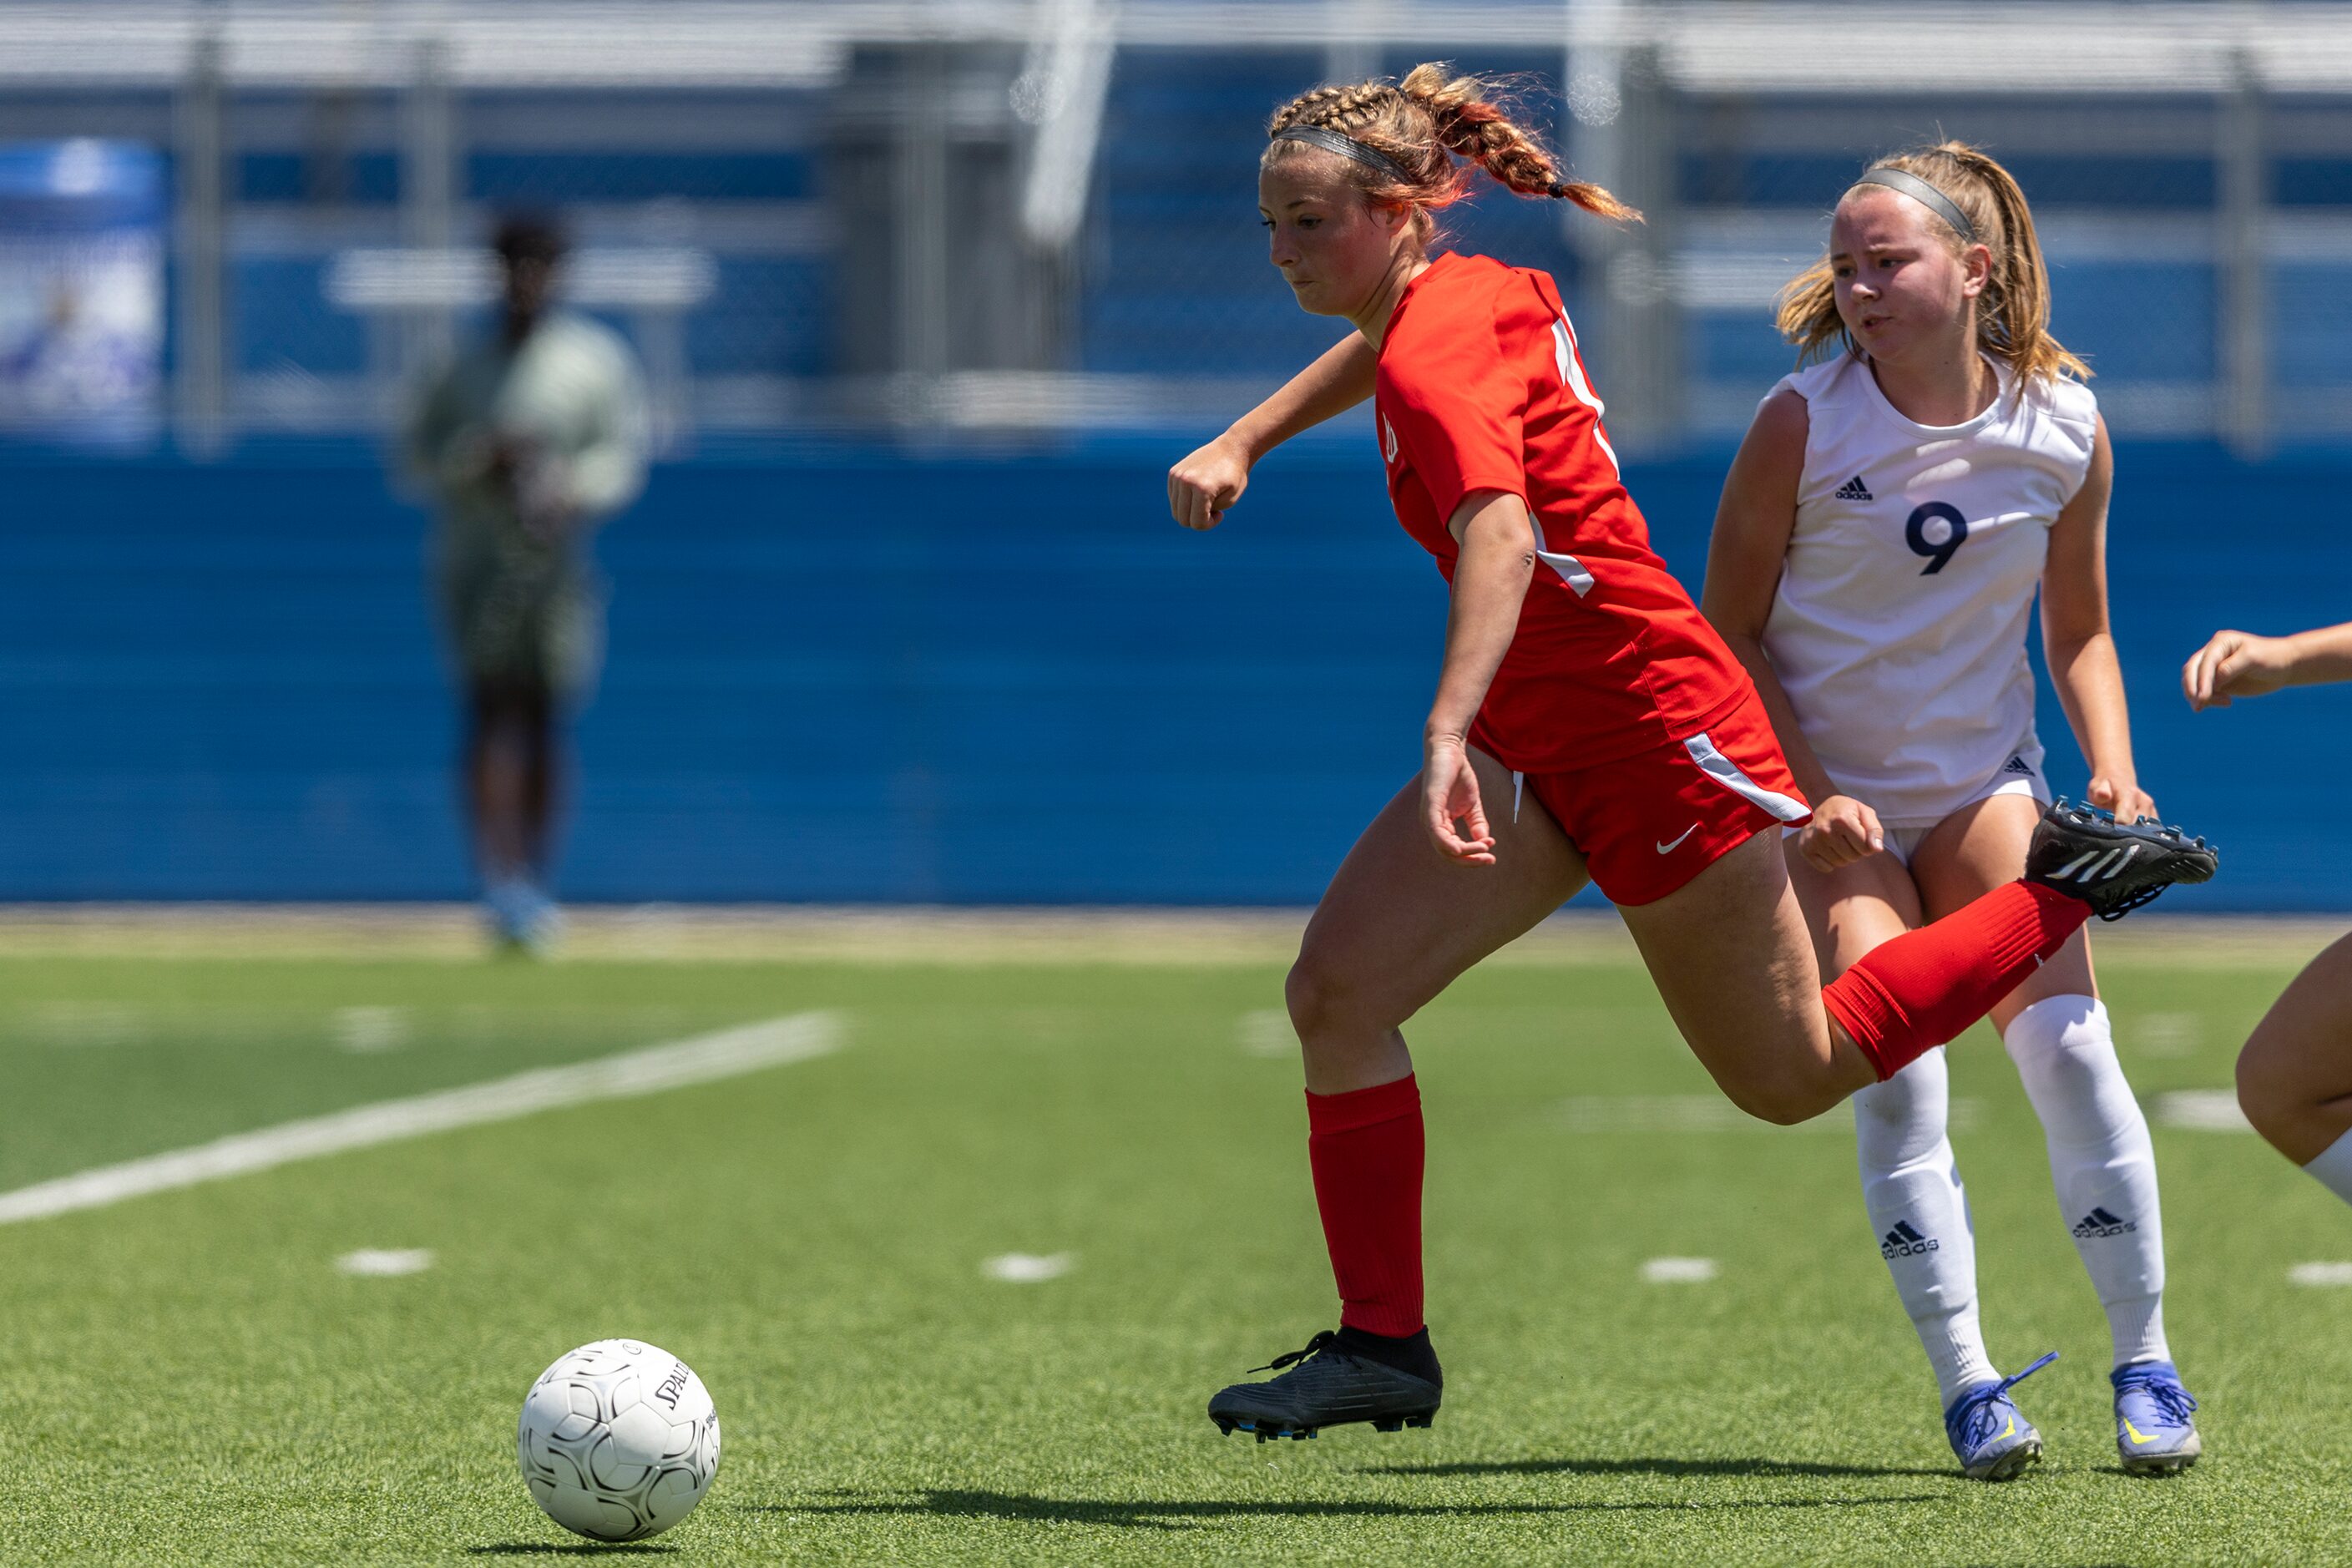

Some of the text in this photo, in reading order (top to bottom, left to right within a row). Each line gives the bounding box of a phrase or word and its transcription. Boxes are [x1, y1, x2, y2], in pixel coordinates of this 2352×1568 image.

[1835, 492, 1873, 501] adidas
[1905, 501, 1967, 576] 9
[2072, 1222, 2137, 1238] adidas
